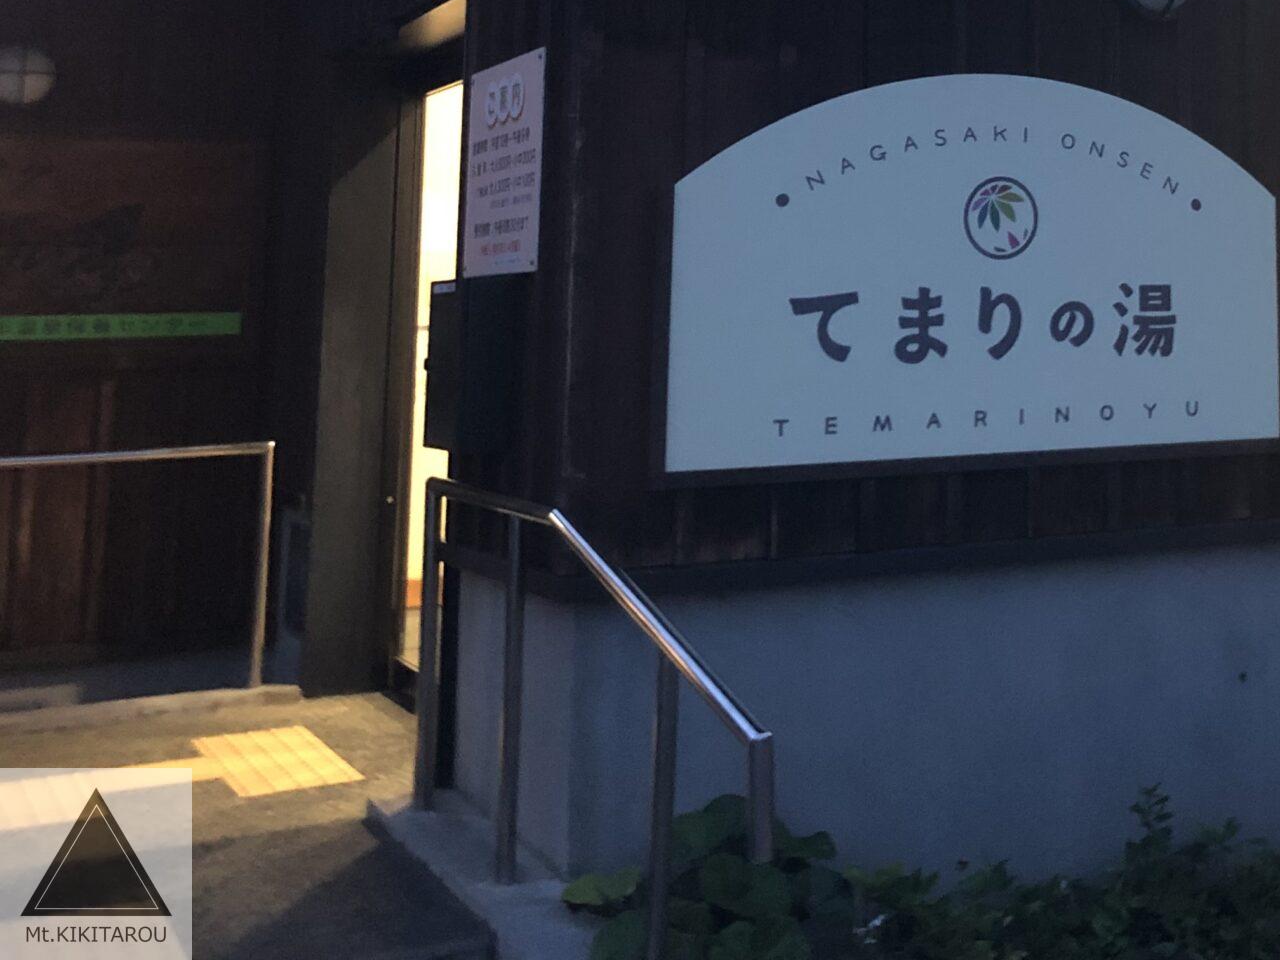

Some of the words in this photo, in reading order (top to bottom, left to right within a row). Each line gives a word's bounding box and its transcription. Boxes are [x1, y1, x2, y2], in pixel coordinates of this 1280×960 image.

[806, 126, 1028, 190] NAGASAKI
[1061, 134, 1179, 195] ONSEN
[789, 283, 1177, 365] てまりの湯
[773, 400, 1200, 438] TEMARINOYU
